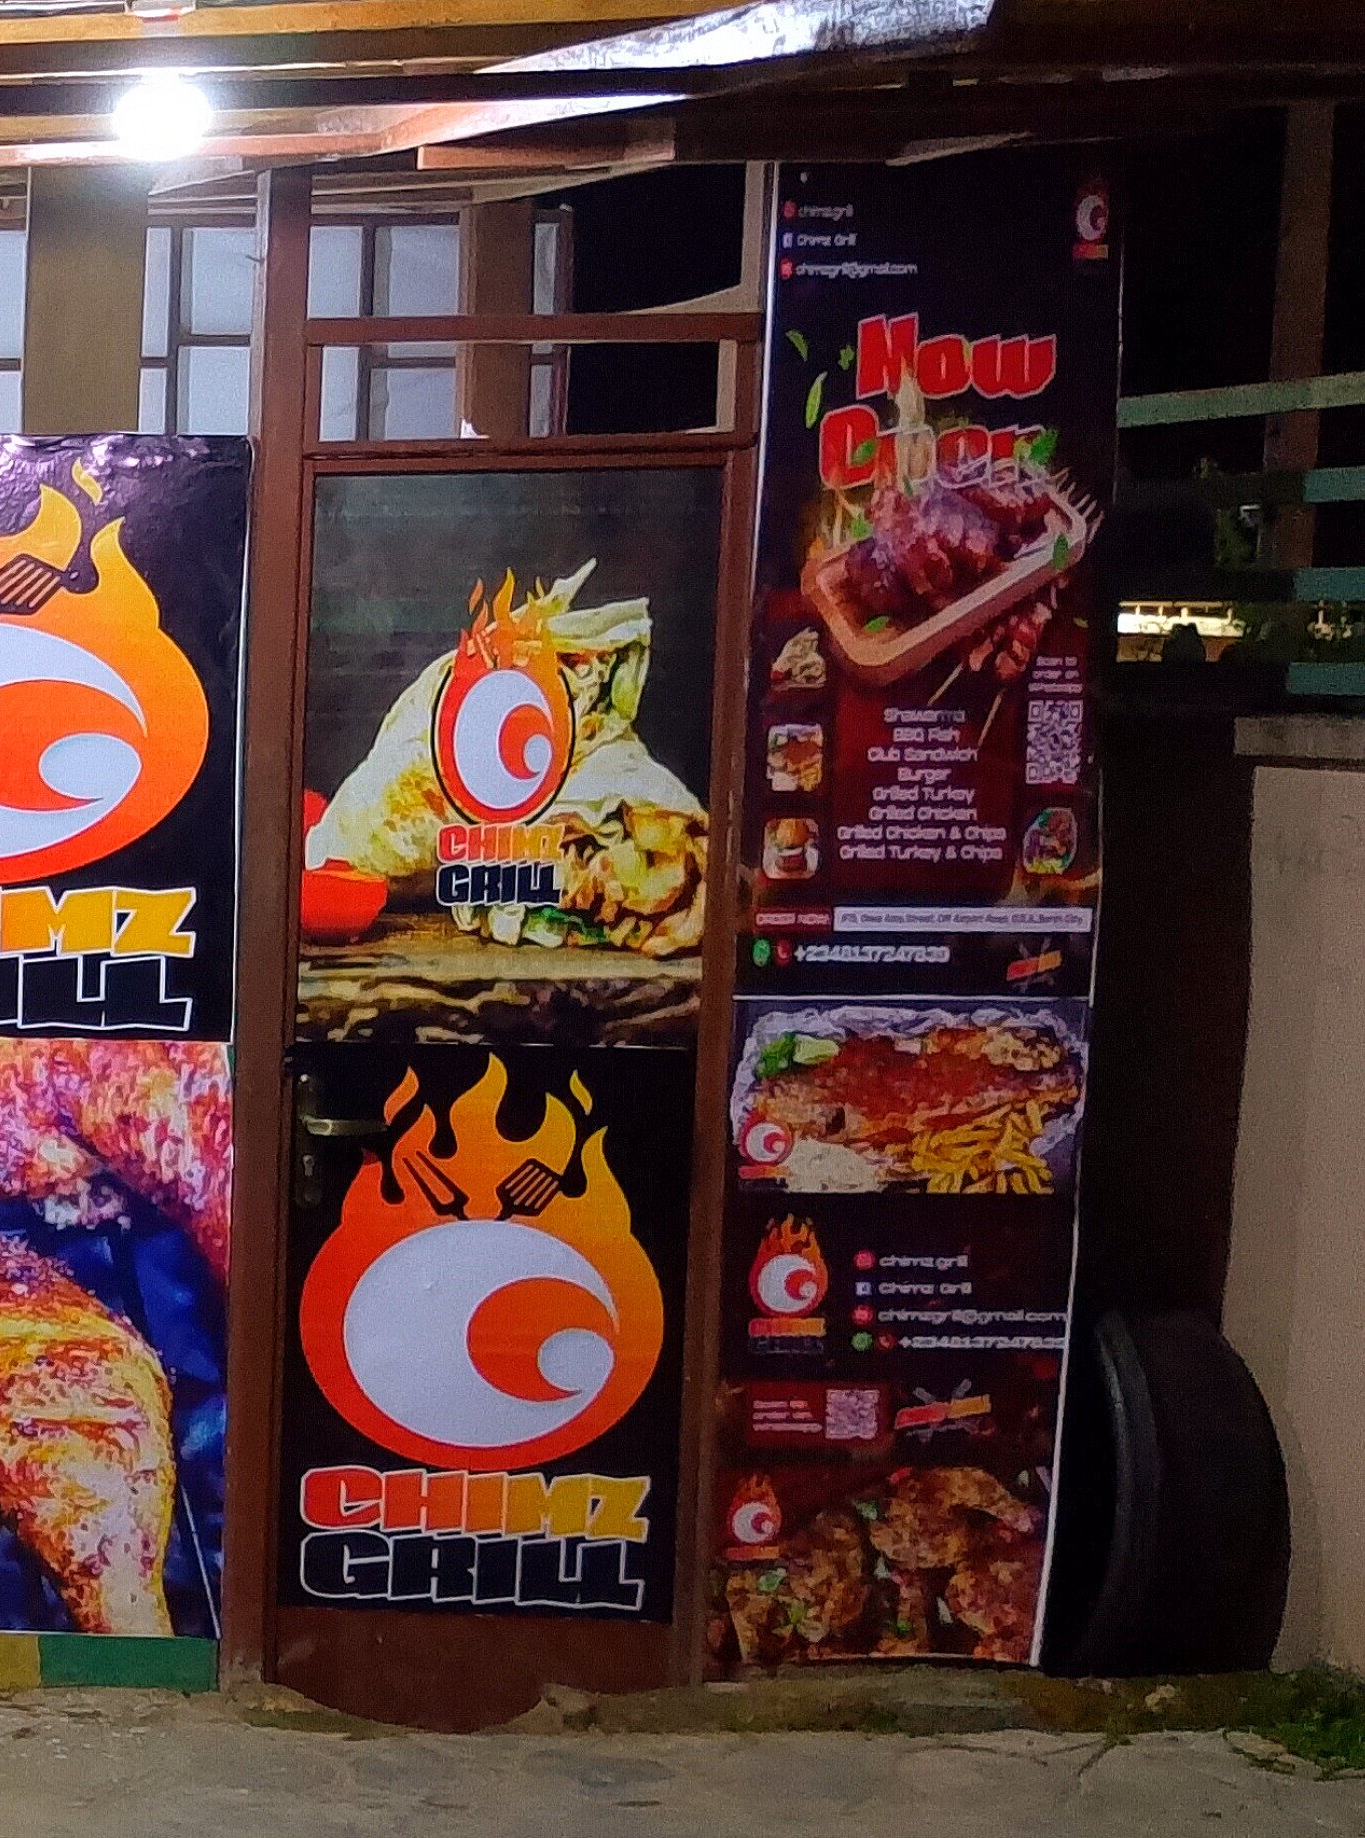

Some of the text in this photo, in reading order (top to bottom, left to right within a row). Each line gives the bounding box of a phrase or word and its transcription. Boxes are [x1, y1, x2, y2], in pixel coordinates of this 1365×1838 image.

[855, 311, 1057, 400] Now
[436, 822, 566, 864] CHIMZ
[435, 863, 564, 908] GRILL
[299, 1463, 651, 1542] CHIMZ
[299, 1529, 646, 1611] GRILL
